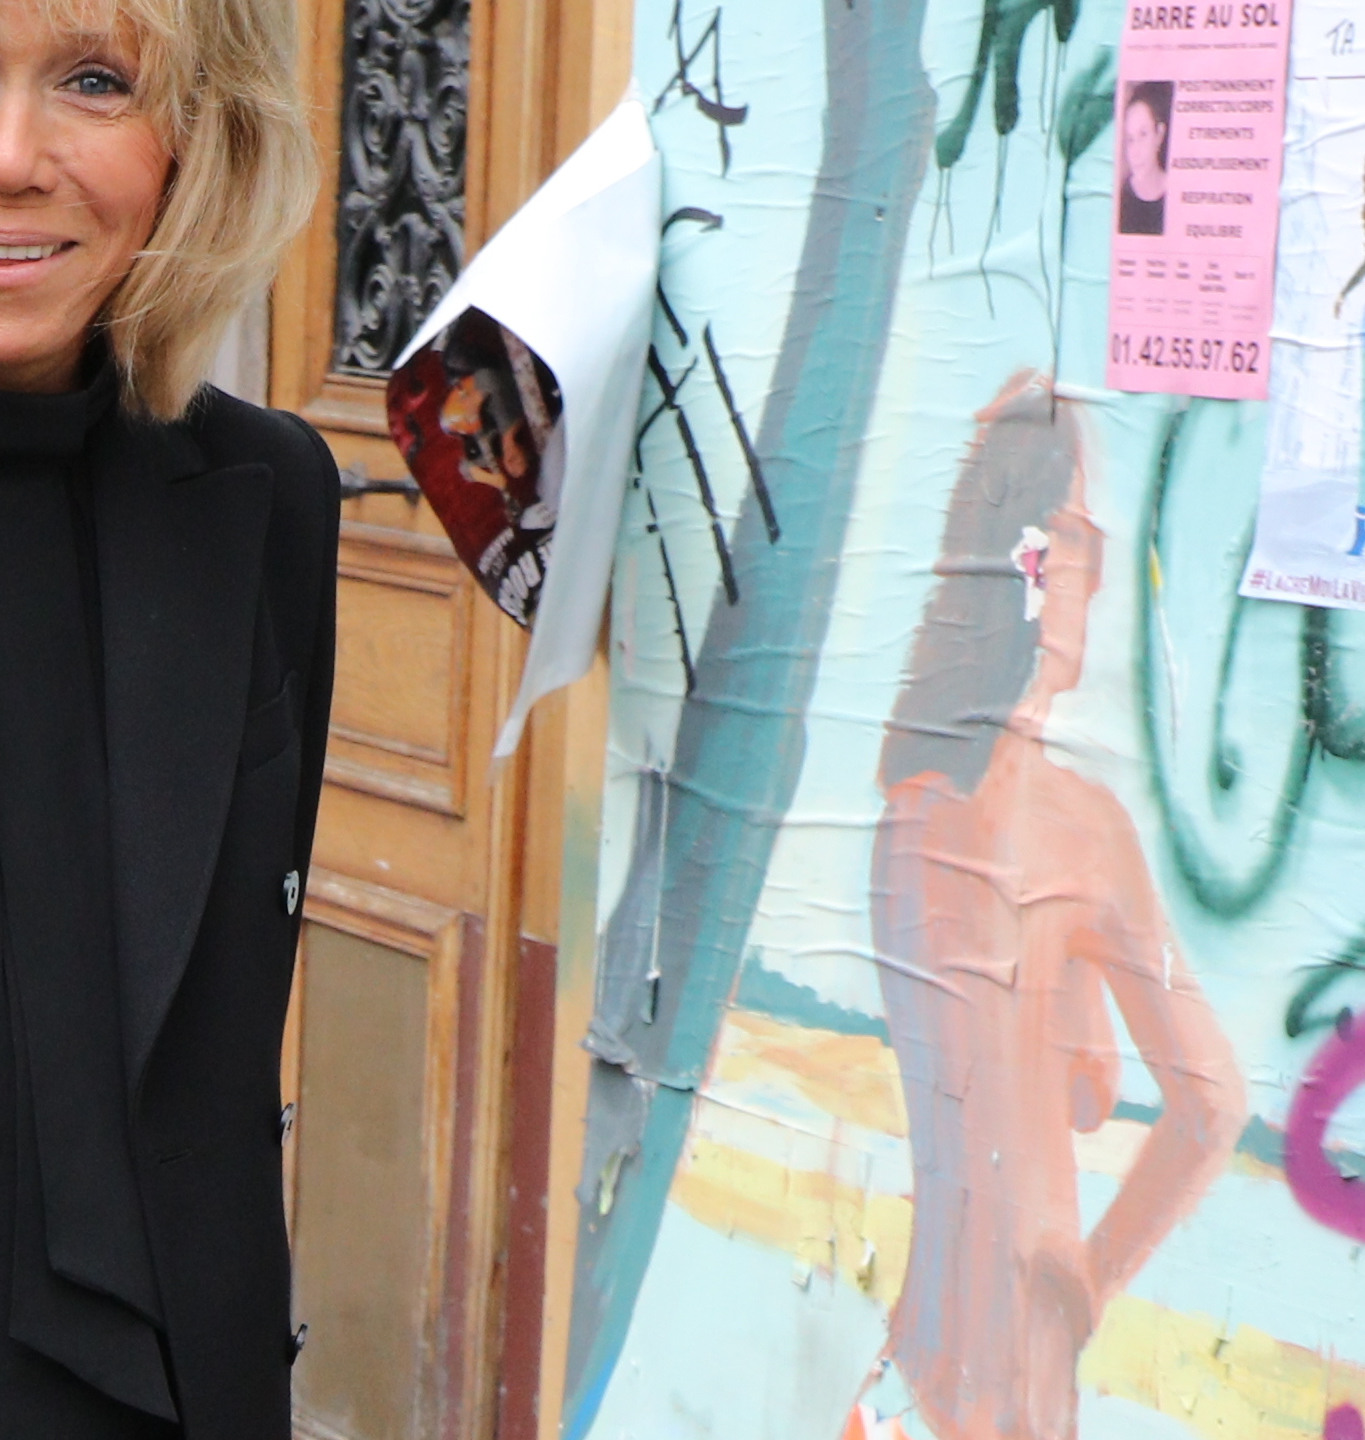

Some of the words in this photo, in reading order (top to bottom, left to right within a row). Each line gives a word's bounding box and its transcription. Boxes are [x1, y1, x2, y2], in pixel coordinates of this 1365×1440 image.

[1131, 6, 1196, 30] BARRE
[1204, 5, 1232, 28] AU
[1240, 3, 1279, 27] SOL
[1178, 79, 1275, 92] POSITIONNEMENT
[1189, 127, 1254, 140] ETIREMENTS
[1181, 192, 1253, 205] RESPIRATION
[1186, 224, 1243, 239] EQUILIBRE
[1111, 333, 1259, 373] 01.42.55.97.62
